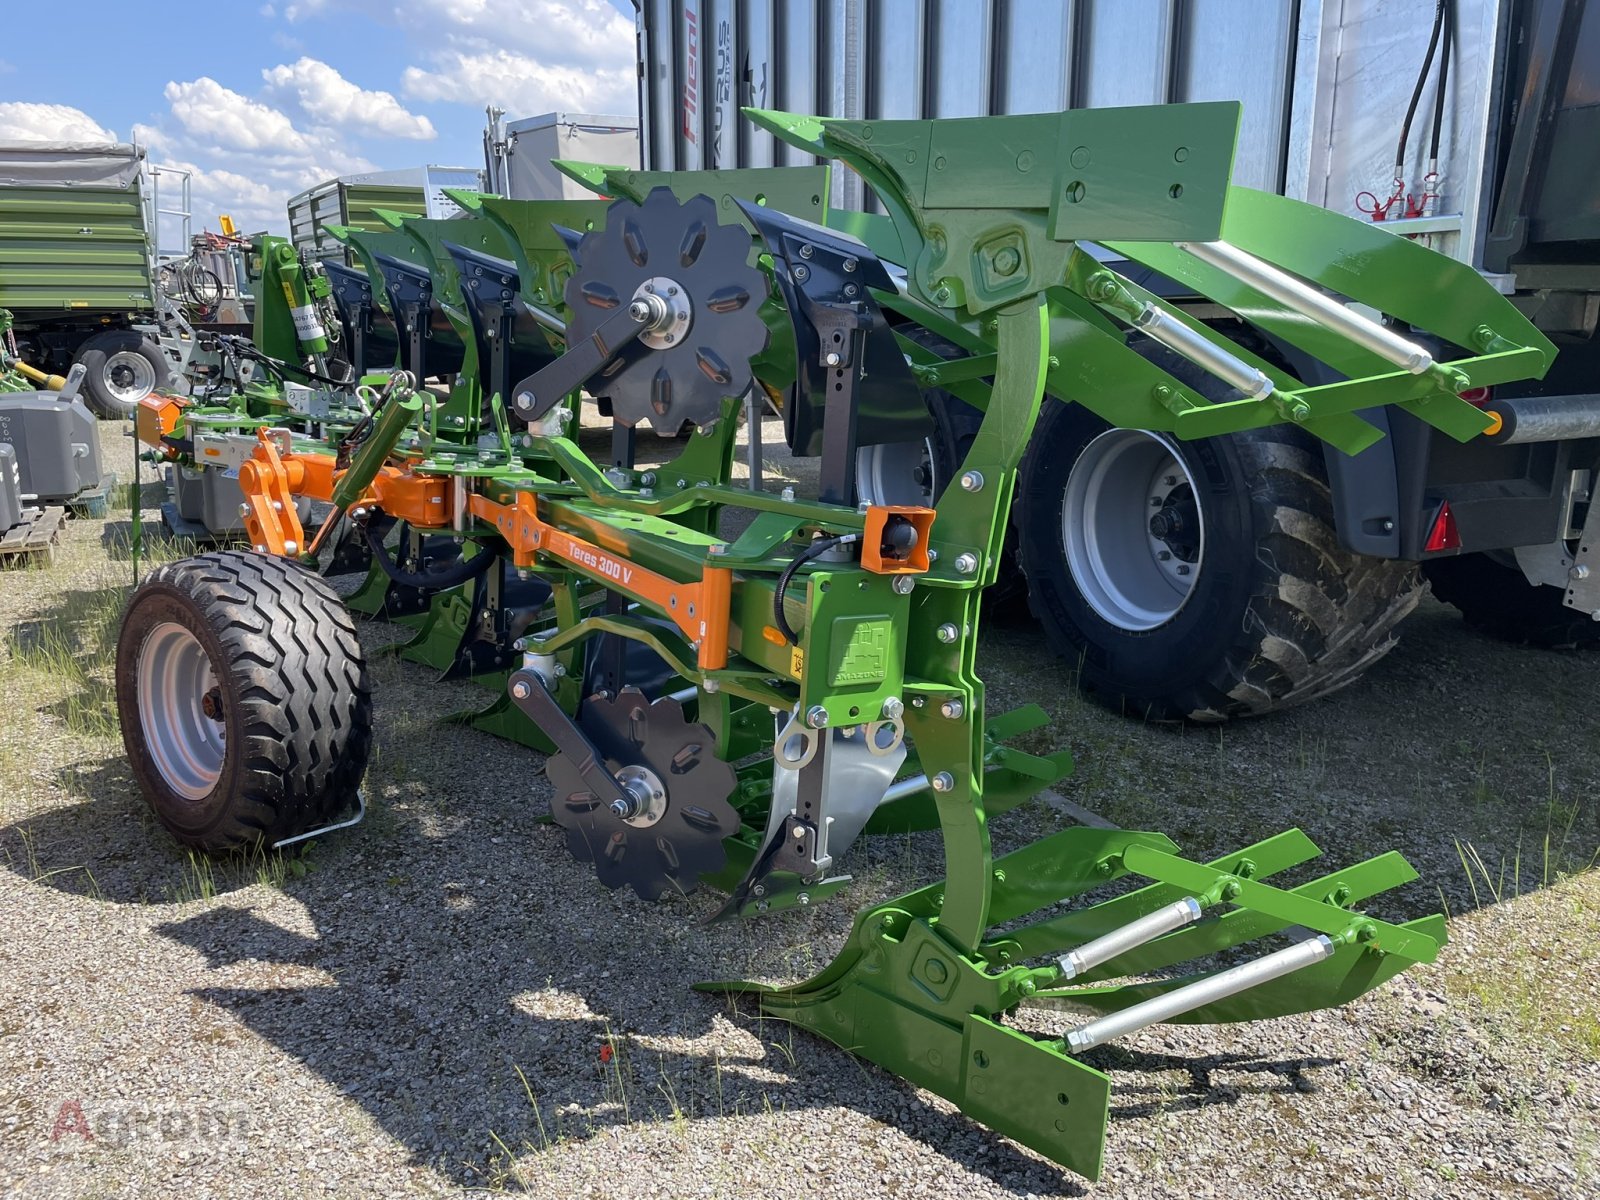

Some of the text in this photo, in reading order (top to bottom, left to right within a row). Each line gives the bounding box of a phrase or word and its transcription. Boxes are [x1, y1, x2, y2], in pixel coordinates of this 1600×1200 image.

[569, 541, 633, 584] Teres 300 V
[835, 670, 885, 681] AMAZONE
